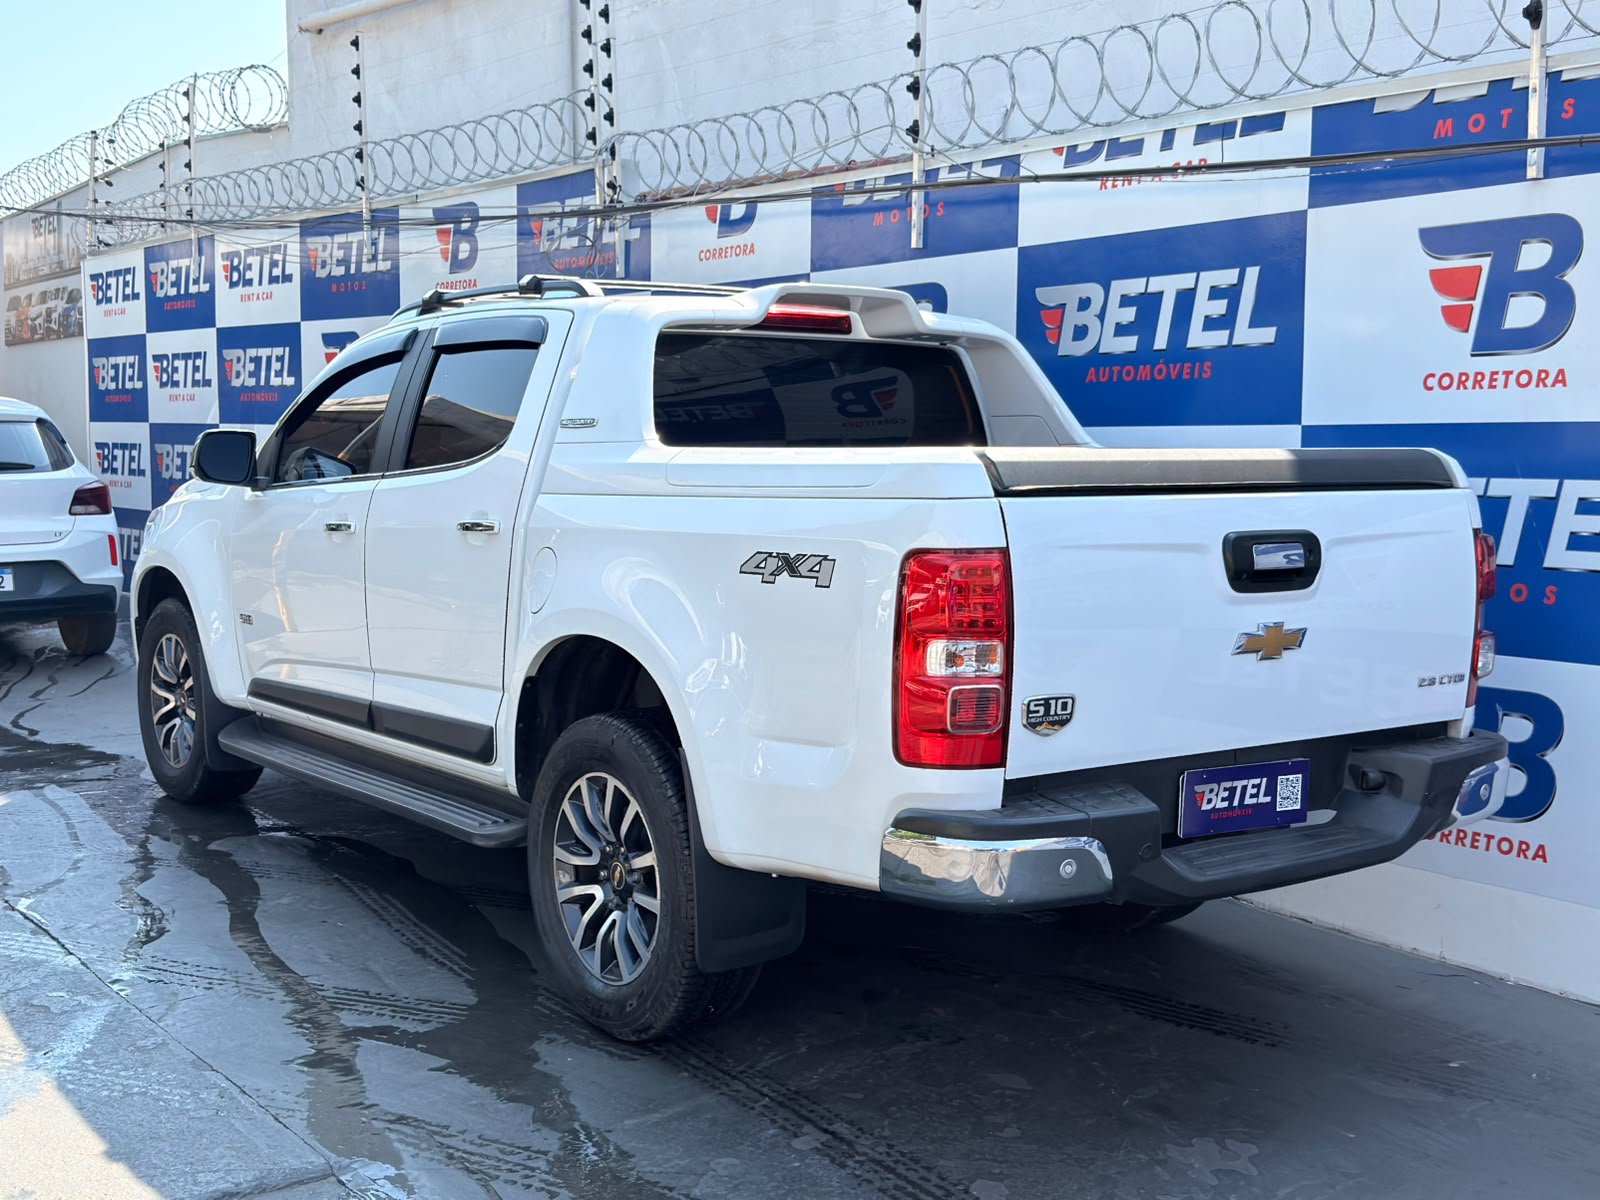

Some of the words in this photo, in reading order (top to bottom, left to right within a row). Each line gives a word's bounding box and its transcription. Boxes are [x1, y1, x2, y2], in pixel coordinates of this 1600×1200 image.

[1433, 97, 1575, 140] MOTS
[221, 244, 293, 289] BETEL
[306, 227, 392, 279] BETEL
[698, 242, 756, 262] CORRETORA
[89, 266, 140, 306] BETEL
[149, 255, 210, 298] BETEL
[331, 280, 368, 293] MOTOS
[435, 278, 478, 290] CORRETORA
[240, 293, 255, 303] RENT
[261, 291, 273, 301] CAR
[1035, 266, 1278, 357] BETEL
[92, 355, 143, 390] BETEL
[152, 351, 212, 389] BETEL
[222, 347, 295, 387] BETEL
[1085, 359, 1213, 383] AUTOMÓVEIS
[1422, 368, 1567, 392] CORRETORA
[94, 442, 146, 477] BETEL
[1028, 698, 1073, 718] S10
[1043, 714, 1072, 722] COUNTRY
[1194, 777, 1272, 811] BETEL
[1425, 828, 1549, 864] RRETORA
